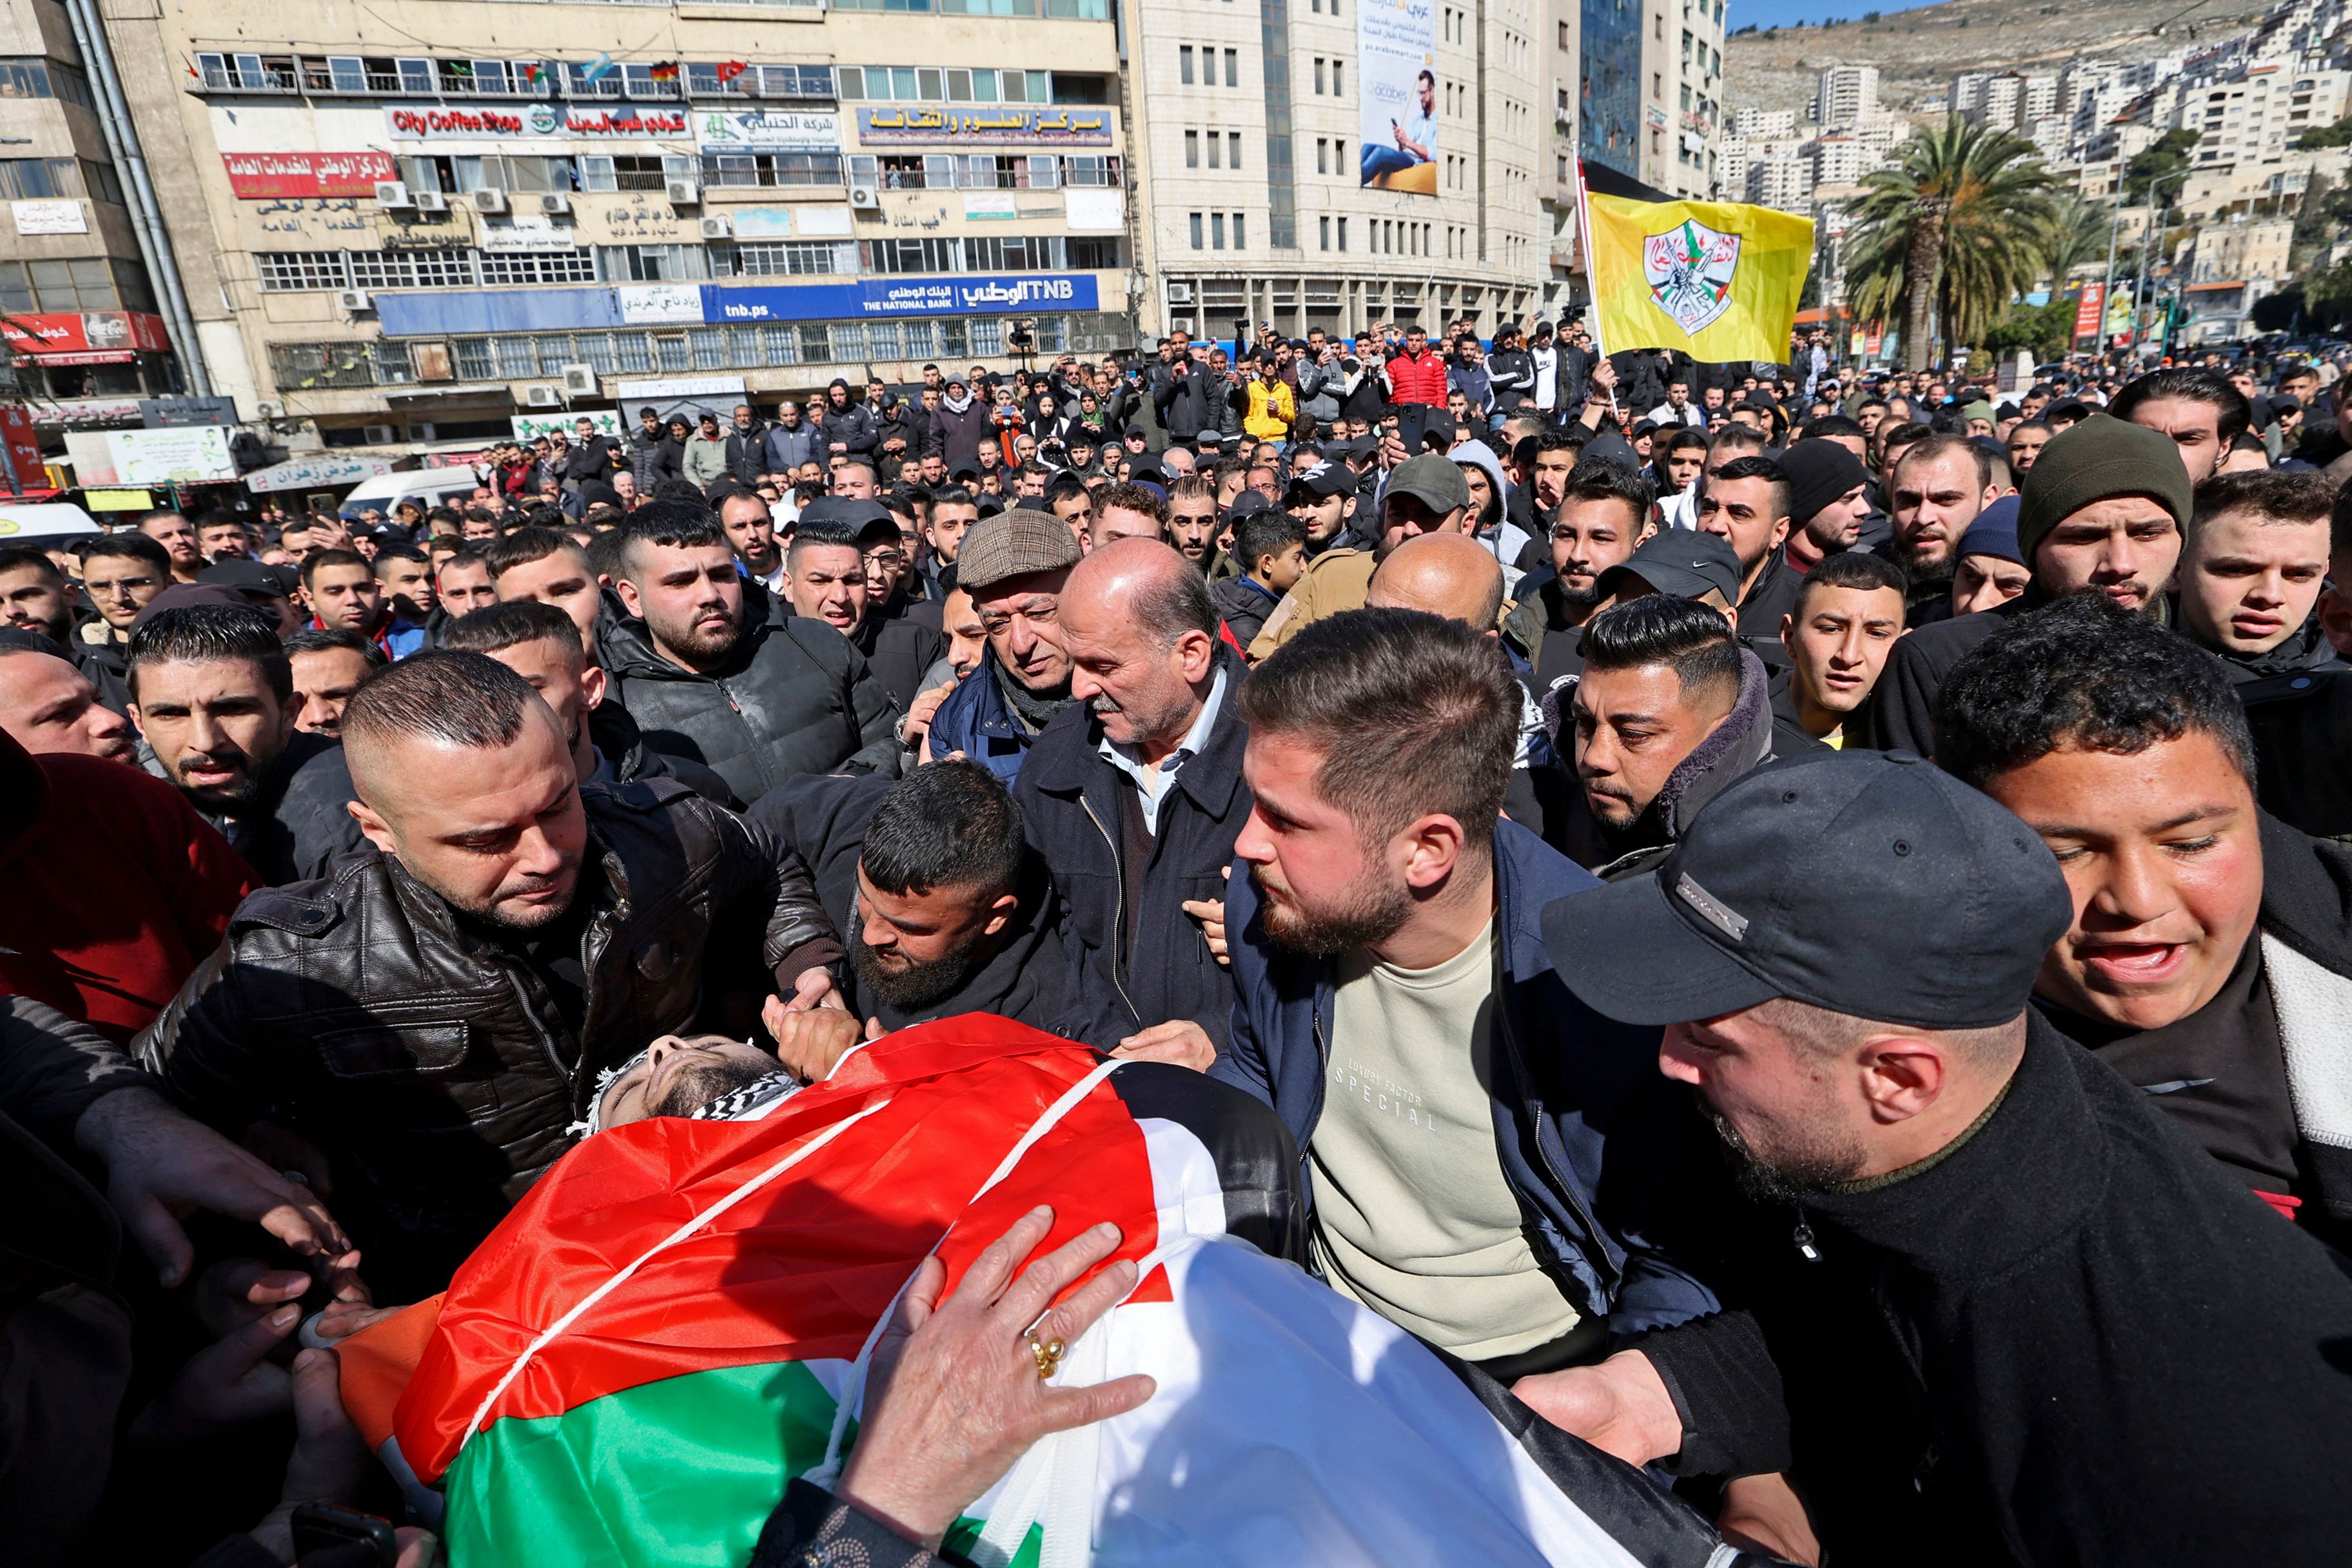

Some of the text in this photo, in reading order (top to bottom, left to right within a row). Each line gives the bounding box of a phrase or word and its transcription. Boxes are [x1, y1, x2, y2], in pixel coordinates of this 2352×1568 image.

[392, 110, 523, 137] City Coffee Shop
[745, 113, 798, 134] الحنبلي
[869, 106, 1102, 133] مركز العلوم والثقافة
[224, 155, 390, 184] المركز الوطني للخدمات العامة
[888, 286, 952, 299] البنك الوطني
[963, 281, 1028, 308] الوطني
[1028, 280, 1073, 300] TNB
[725, 304, 769, 319] tnb.ps
[863, 299, 952, 311] THE NATIONAL BANK
[1348, 1058, 1422, 1108] LUXURY FACTOR
[1335, 1067, 1436, 1133] SPECIAL
